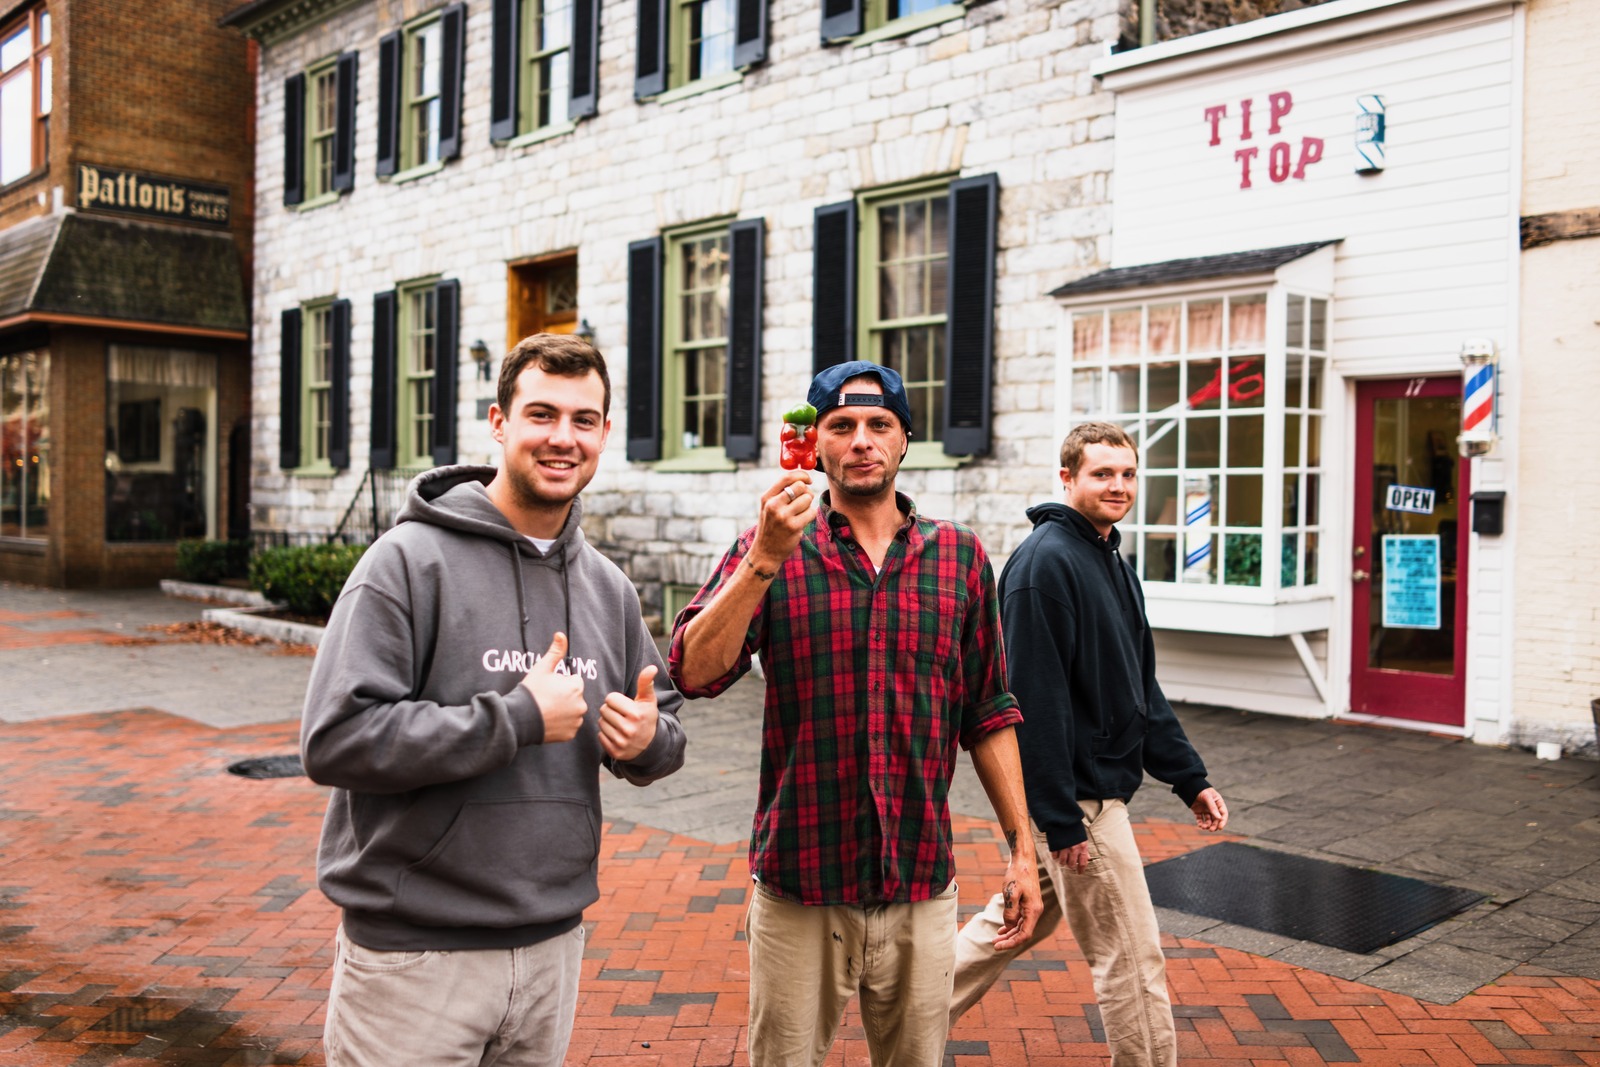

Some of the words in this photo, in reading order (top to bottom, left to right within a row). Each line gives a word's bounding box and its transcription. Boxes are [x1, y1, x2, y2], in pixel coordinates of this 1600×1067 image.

[1204, 91, 1294, 147] TIP
[1234, 136, 1325, 190] TOP
[189, 202, 228, 221] SALES
[1391, 489, 1431, 510] OPEN
